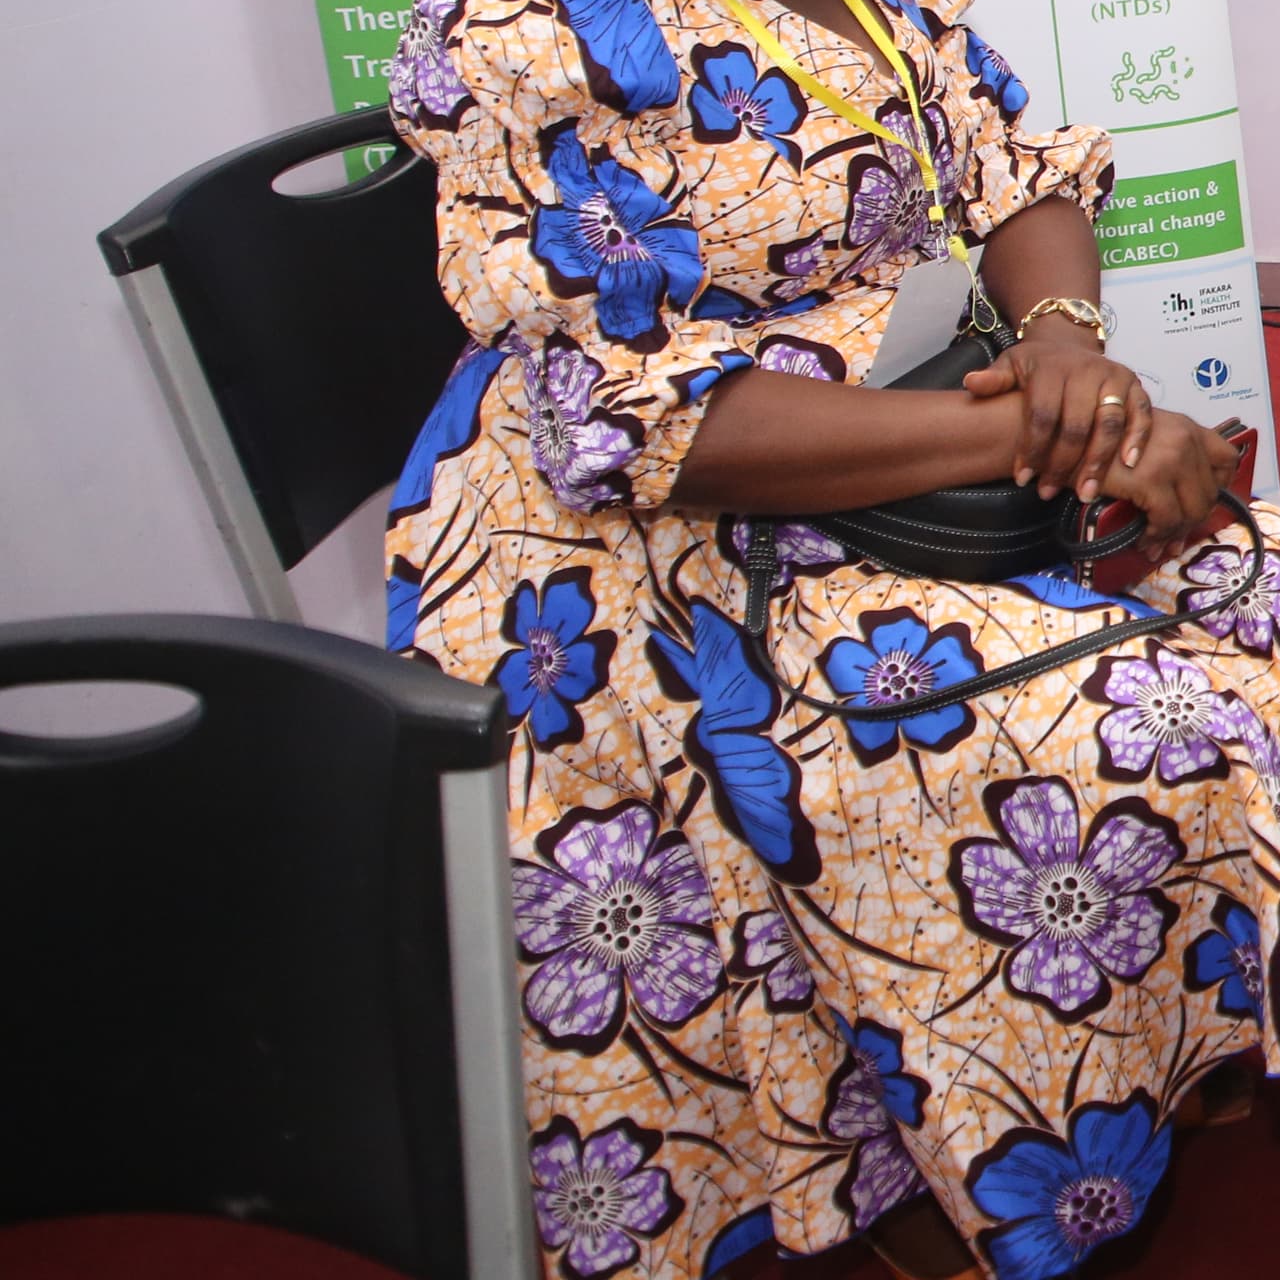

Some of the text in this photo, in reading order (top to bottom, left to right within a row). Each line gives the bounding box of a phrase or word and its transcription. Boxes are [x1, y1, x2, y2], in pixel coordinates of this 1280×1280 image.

[1143, 185, 1199, 210] action
[1205, 180, 1220, 197] &
[1161, 206, 1226, 235] change
[1102, 240, 1179, 267] (CABEC)
[1199, 283, 1232, 296] IFAKARA
[1200, 294, 1231, 305] HEALTH
[1201, 300, 1241, 315] INSTITUTE
